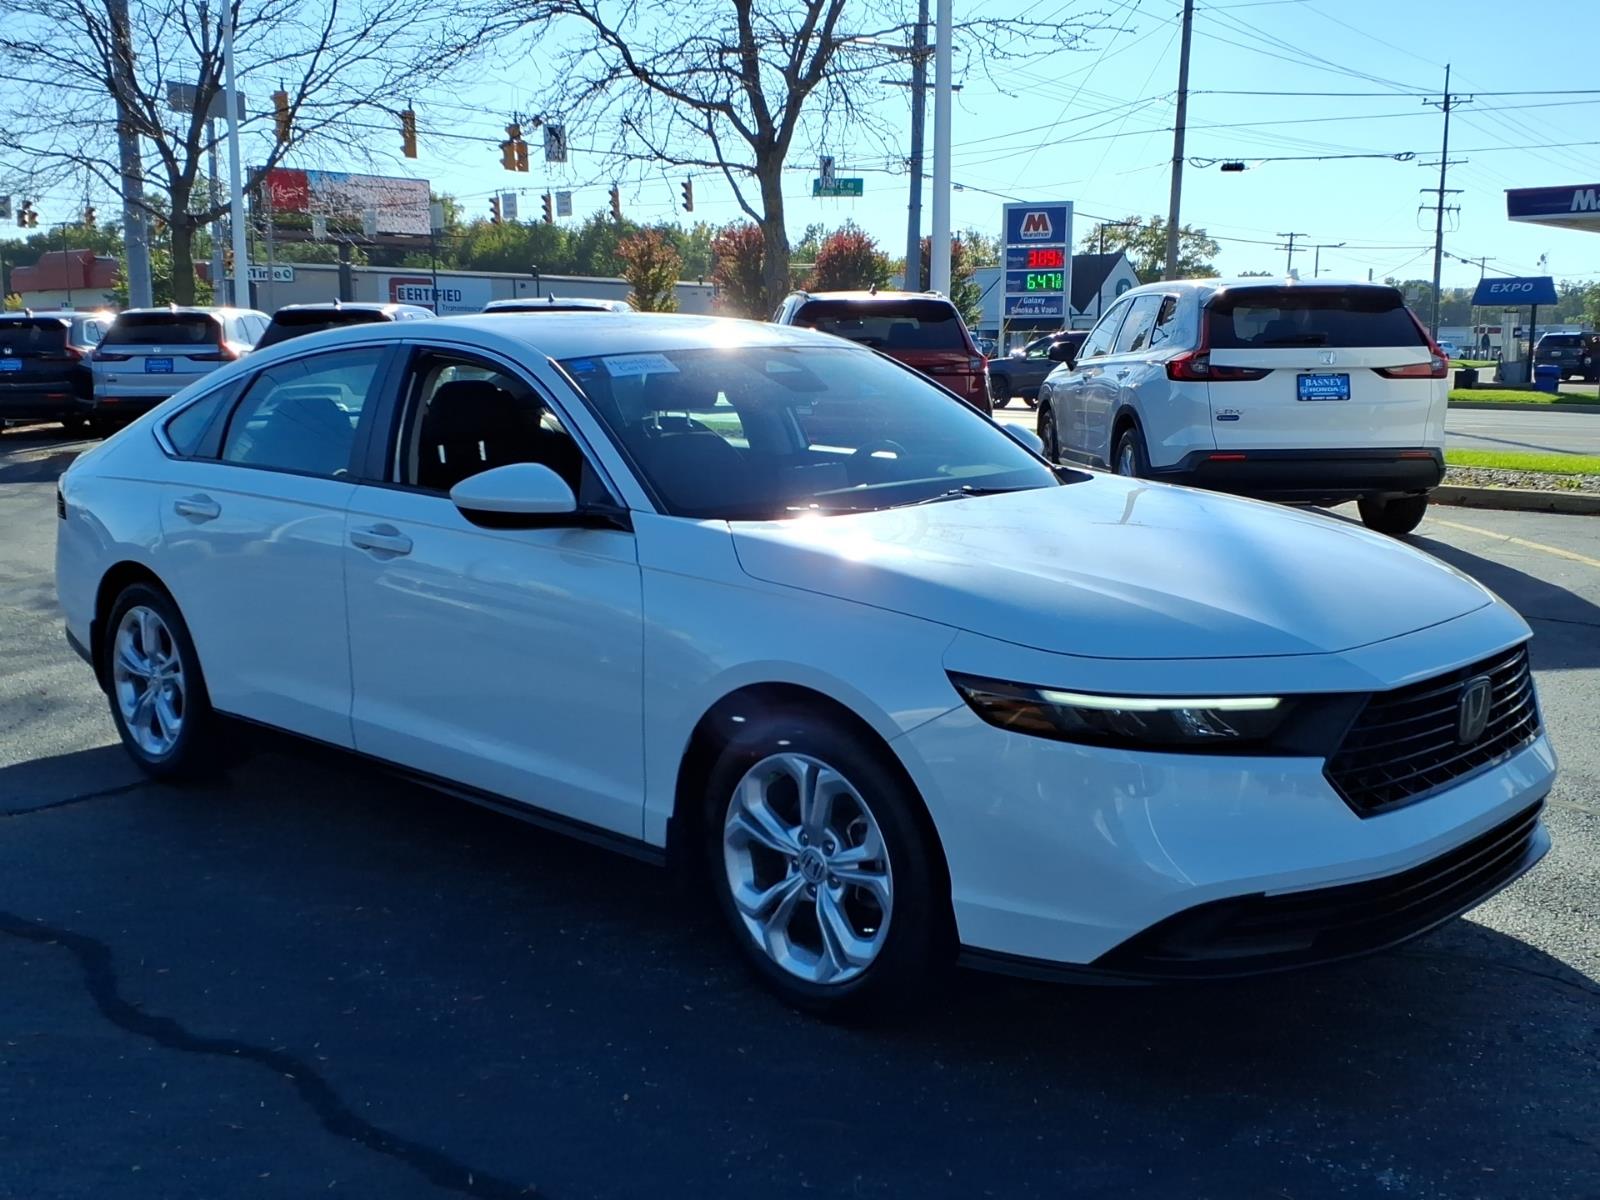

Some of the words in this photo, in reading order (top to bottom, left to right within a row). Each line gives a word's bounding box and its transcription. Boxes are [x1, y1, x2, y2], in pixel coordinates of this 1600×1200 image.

[1570, 189, 1600, 211] M
[1023, 213, 1049, 232] M
[1489, 282, 1534, 293] EXPO
[397, 287, 462, 302] CERTIFIED
[1023, 297, 1045, 306] Galaxy
[1010, 306, 1033, 315] Smoke
[1305, 378, 1342, 387] BASNEY
